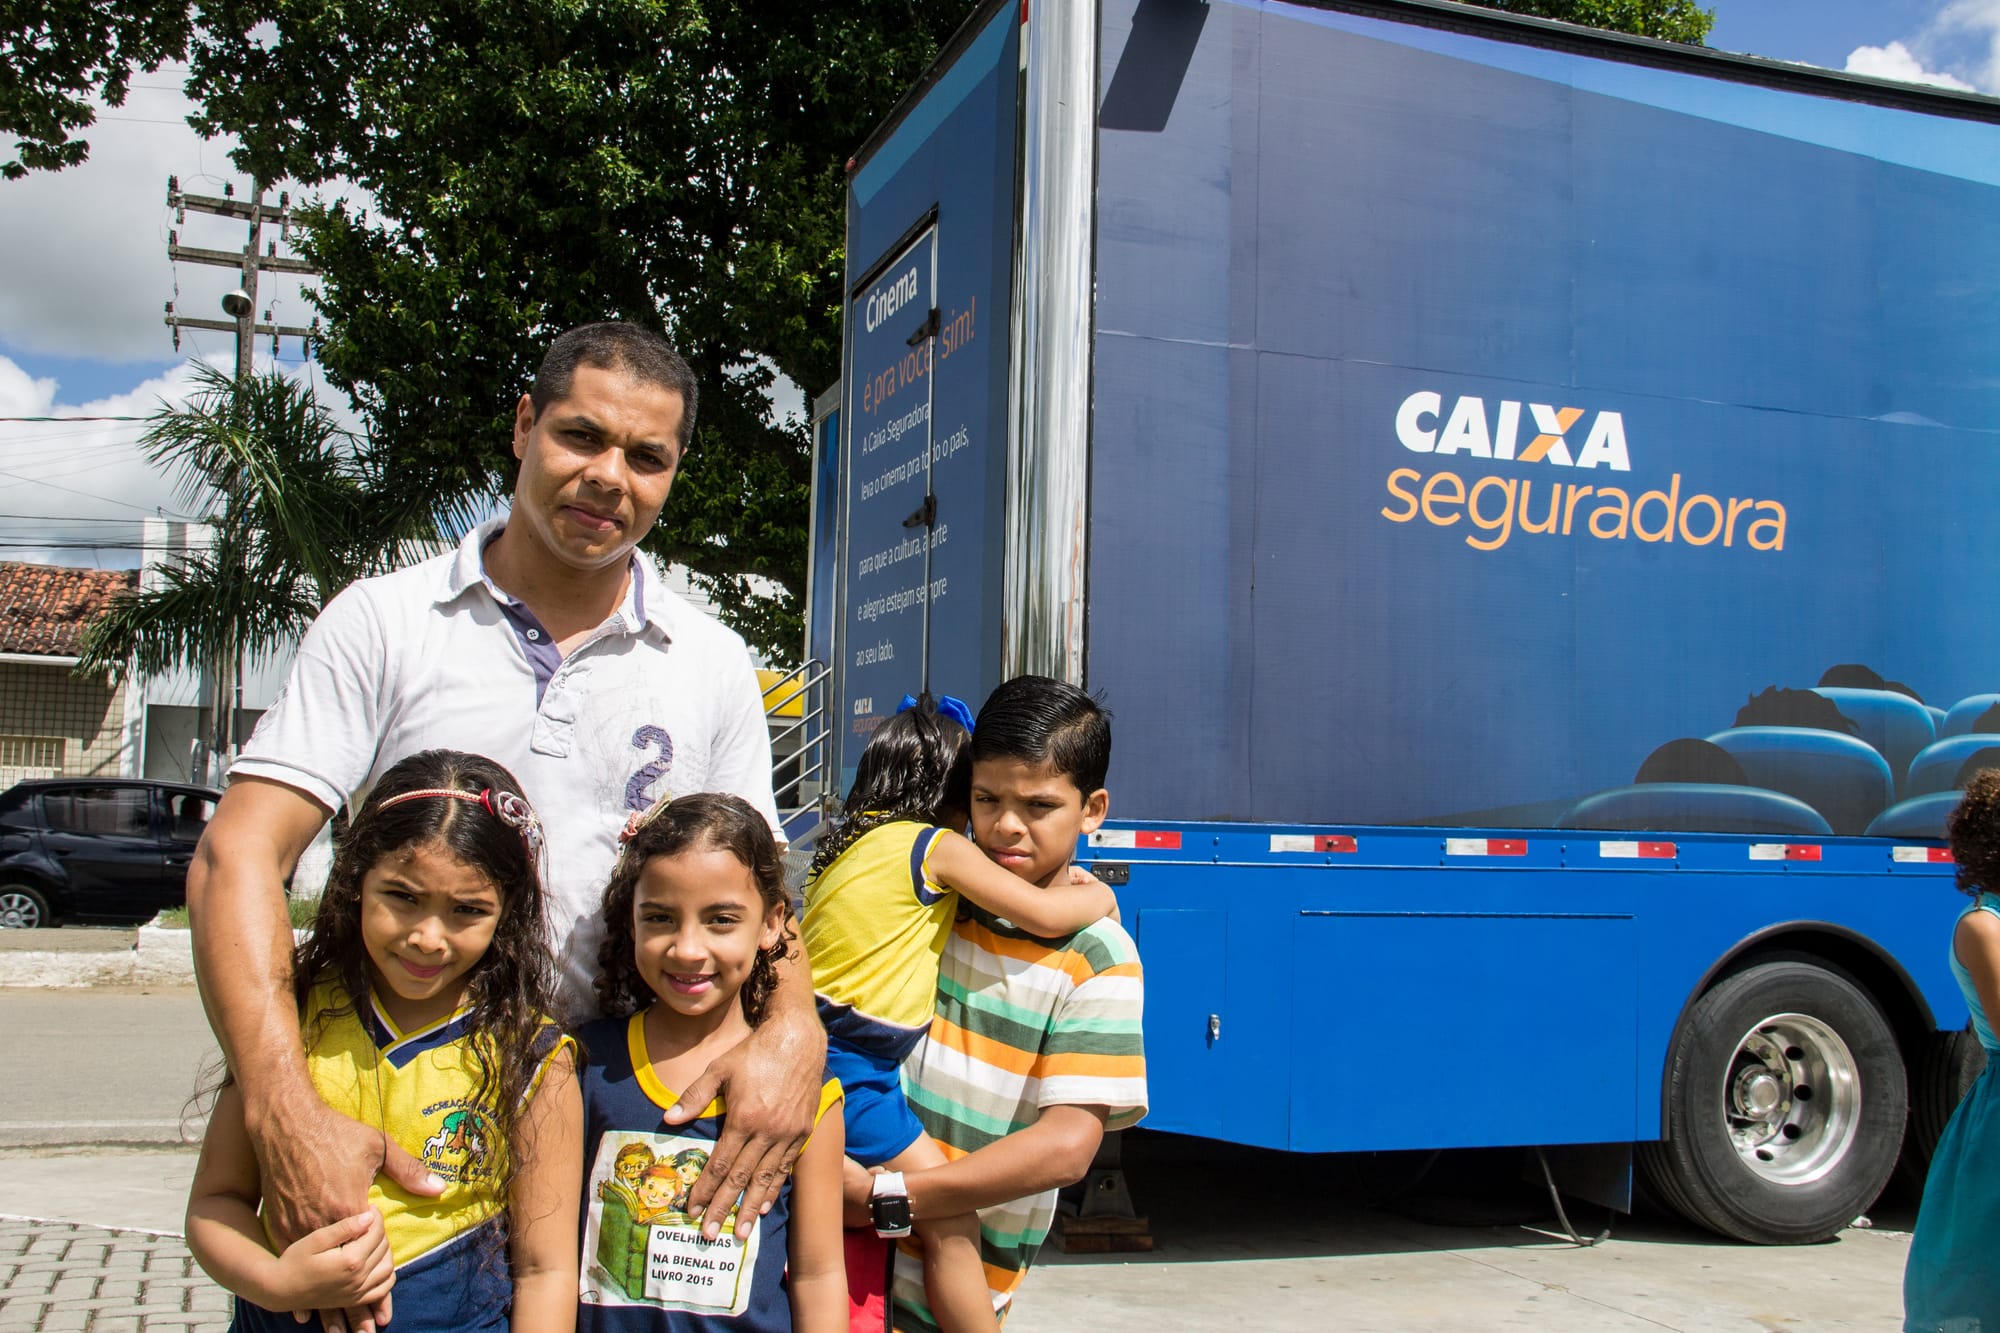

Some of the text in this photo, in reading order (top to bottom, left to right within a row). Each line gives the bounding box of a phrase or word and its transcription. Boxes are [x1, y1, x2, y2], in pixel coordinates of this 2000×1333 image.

[866, 266, 918, 333] Cinema
[863, 371, 872, 413] é
[873, 365, 896, 417] pra
[941, 295, 976, 359] sim!
[862, 402, 929, 457] A Caixa Seguradora
[1395, 391, 1631, 472] CAIXA
[861, 480, 874, 502] leva
[874, 477, 880, 494] o
[880, 467, 906, 491] cinema
[907, 456, 920, 484] pra
[942, 439, 949, 457] o
[949, 423, 969, 459] país,
[1381, 468, 1787, 551] seguradora
[858, 556, 873, 581] para
[874, 550, 887, 574] que
[888, 548, 893, 565] a
[894, 536, 921, 557] cultura,
[930, 521, 948, 549] arte
[857, 604, 863, 621] e
[863, 592, 885, 622] alegria
[886, 585, 915, 615] estejam
[856, 638, 895, 667] ao seu lado.
[624, 724, 674, 812] 2
[652, 1252, 735, 1272] NA BIENAL DO
[656, 1230, 732, 1248] OVELHINHAS
[651, 1269, 714, 1286] LIVRO 2015
